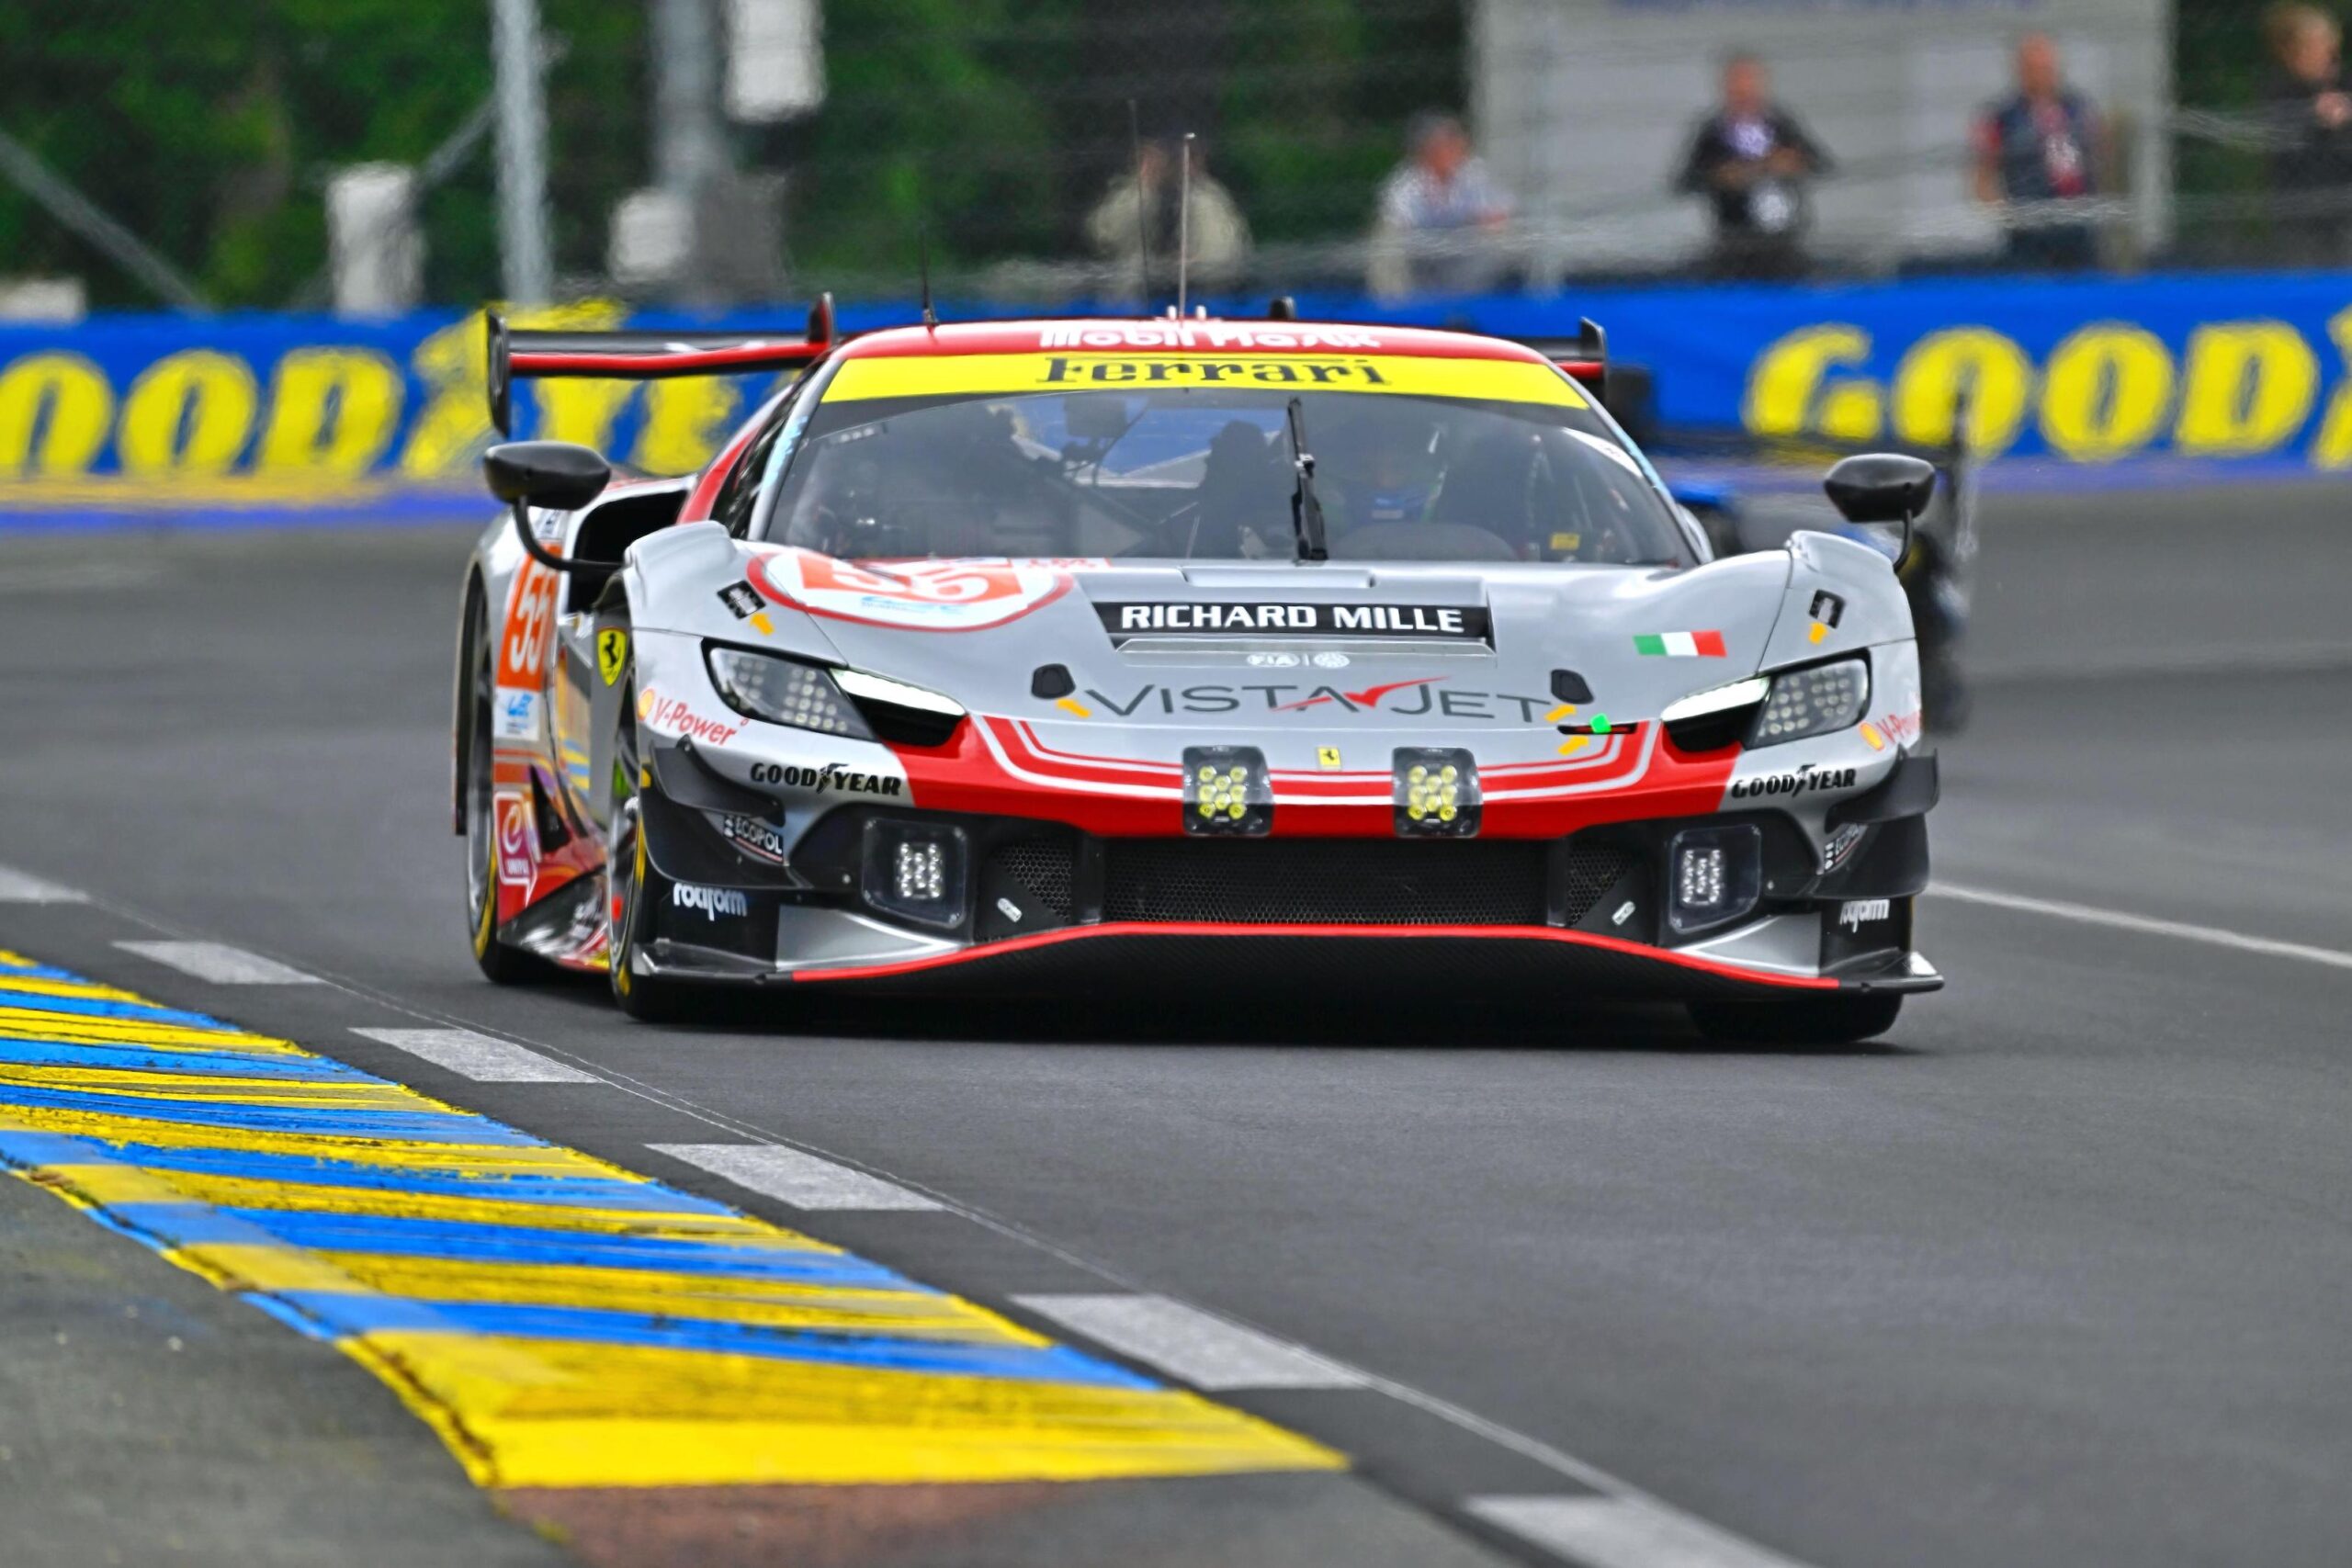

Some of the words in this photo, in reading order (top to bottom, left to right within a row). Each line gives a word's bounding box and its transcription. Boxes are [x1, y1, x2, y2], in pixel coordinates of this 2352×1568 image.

[1036, 357, 1393, 385] Ferrari
[510, 558, 559, 675] 55
[1121, 604, 1317, 629] RICHARD
[1333, 607, 1465, 633] MILLE
[652, 696, 739, 747] V-Power
[750, 761, 901, 796] GOODYEAR
[1731, 765, 1857, 799] GOODYEAR
